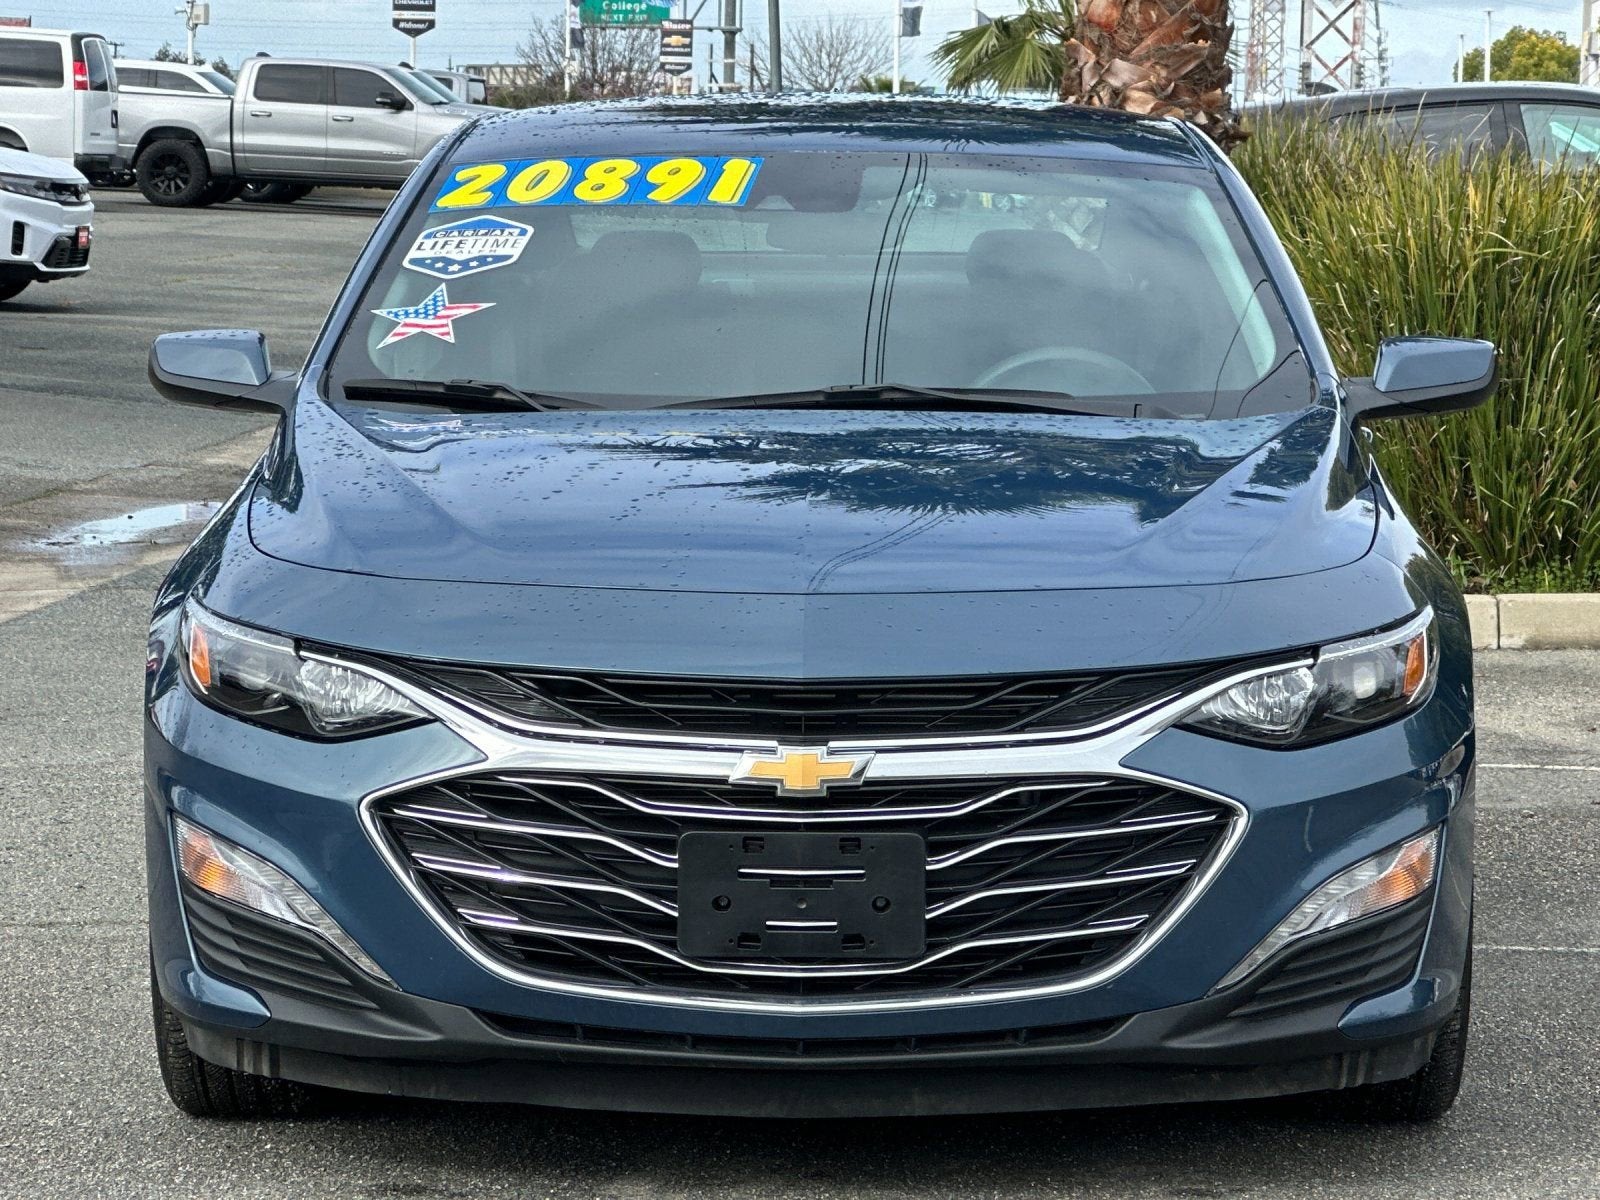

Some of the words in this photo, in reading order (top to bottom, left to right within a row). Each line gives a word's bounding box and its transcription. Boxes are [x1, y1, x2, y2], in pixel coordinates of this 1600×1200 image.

[602, 1, 647, 13] College
[436, 157, 757, 208] 20891
[431, 228, 520, 239] CARFAX
[416, 238, 524, 251] LIFETIME
